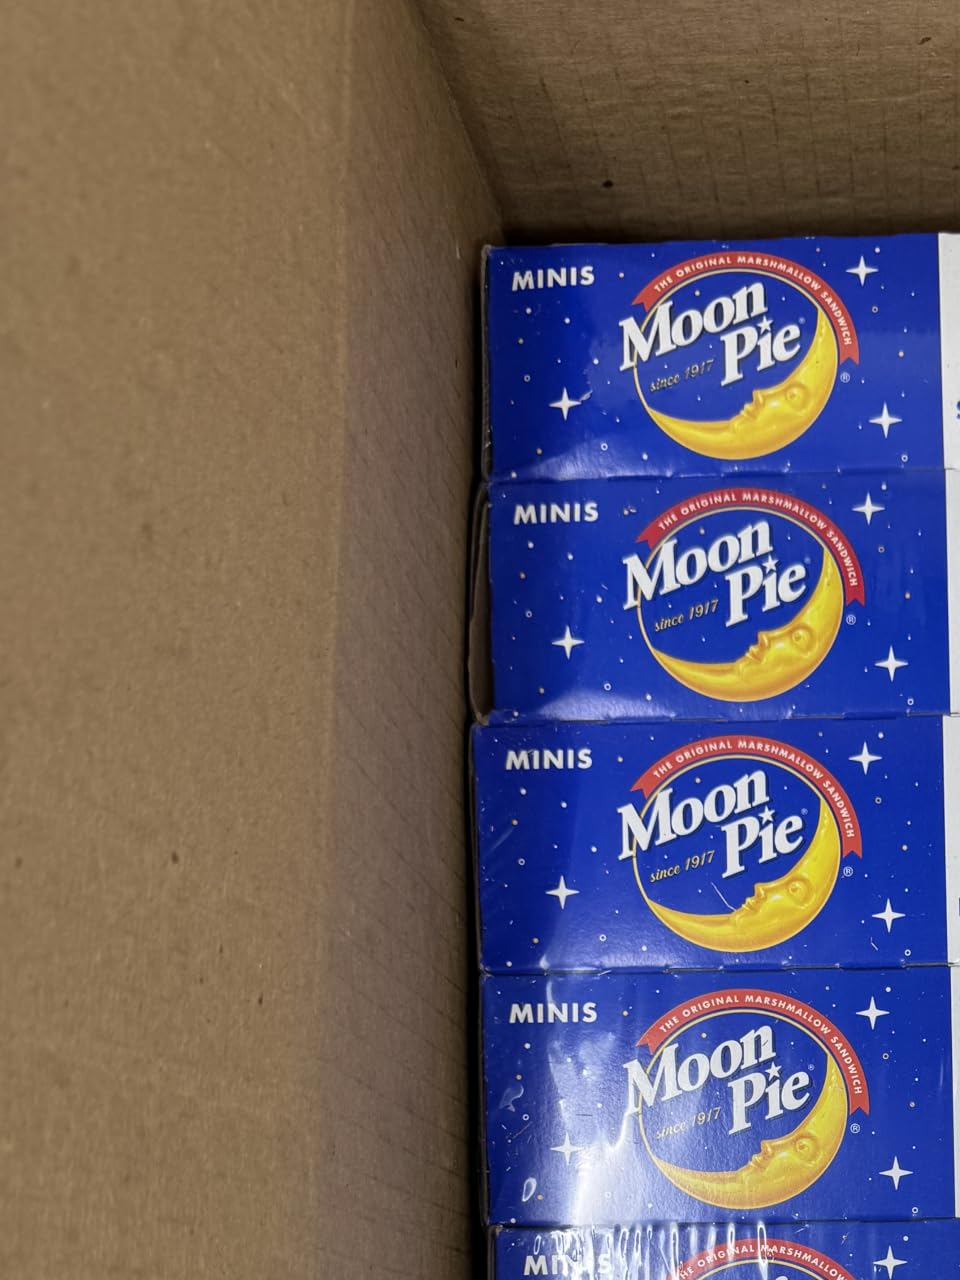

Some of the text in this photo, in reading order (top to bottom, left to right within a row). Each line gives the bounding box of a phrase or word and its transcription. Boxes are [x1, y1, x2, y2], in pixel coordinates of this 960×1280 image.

[512, 266, 594, 291] MINIS
[654, 256, 852, 346] THE ORIGINAL MARSHMALLOW SANDWICH
[618, 282, 801, 386] Moon Pie
[684, 359, 714, 379] 1917
[514, 502, 599, 525] MINIS
[658, 493, 858, 587] THE ORIGINAL MARSHMALLOW SANDWICH
[622, 520, 806, 628] Moon Pie
[654, 599, 719, 632] since 1917
[505, 748, 593, 771] MINIS
[653, 741, 856, 838] THE ORIGINAL MARSHMALLOW SANDWICH
[616, 770, 803, 879] Moon Pie
[649, 849, 716, 884] since 1917
[509, 1002, 598, 1024] MINIS
[659, 994, 863, 1095] THE ORIGINAL MARSHMALLOW SANDWICH
[623, 1025, 810, 1135] Moon Pie
[656, 1106, 721, 1139] since 1917
[523, 1253, 613, 1276] MINS
[697, 1244, 755, 1268] ORIGINAL
